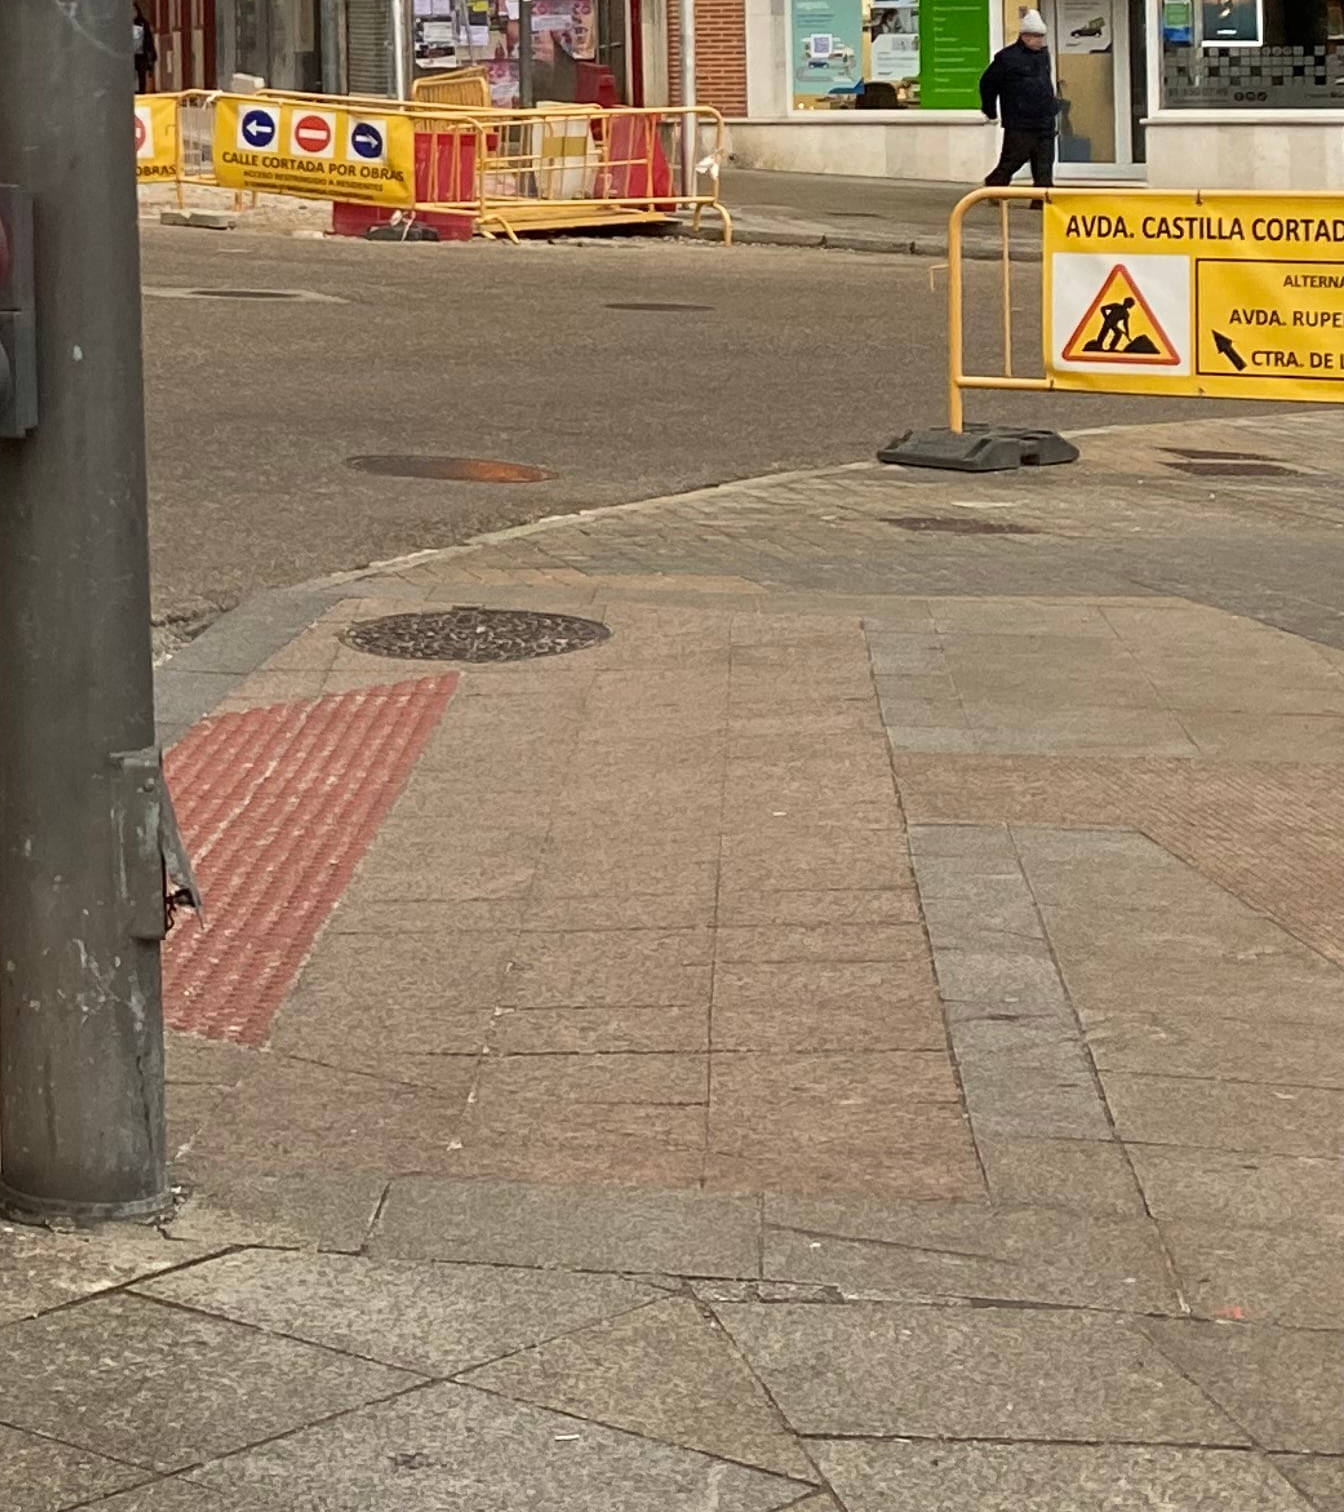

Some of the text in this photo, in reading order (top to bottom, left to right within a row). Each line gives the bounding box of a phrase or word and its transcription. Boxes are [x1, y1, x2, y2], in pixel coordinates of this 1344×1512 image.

[222, 151, 404, 182] CALLE CORTADA POR OBRAS
[1066, 215, 1135, 238] AVDA.
[1142, 216, 1246, 241] CASTILLA
[1229, 309, 1342, 328] AVDA. RUPE
[1251, 350, 1304, 368] CTRA.
[1310, 352, 1334, 369] DE
